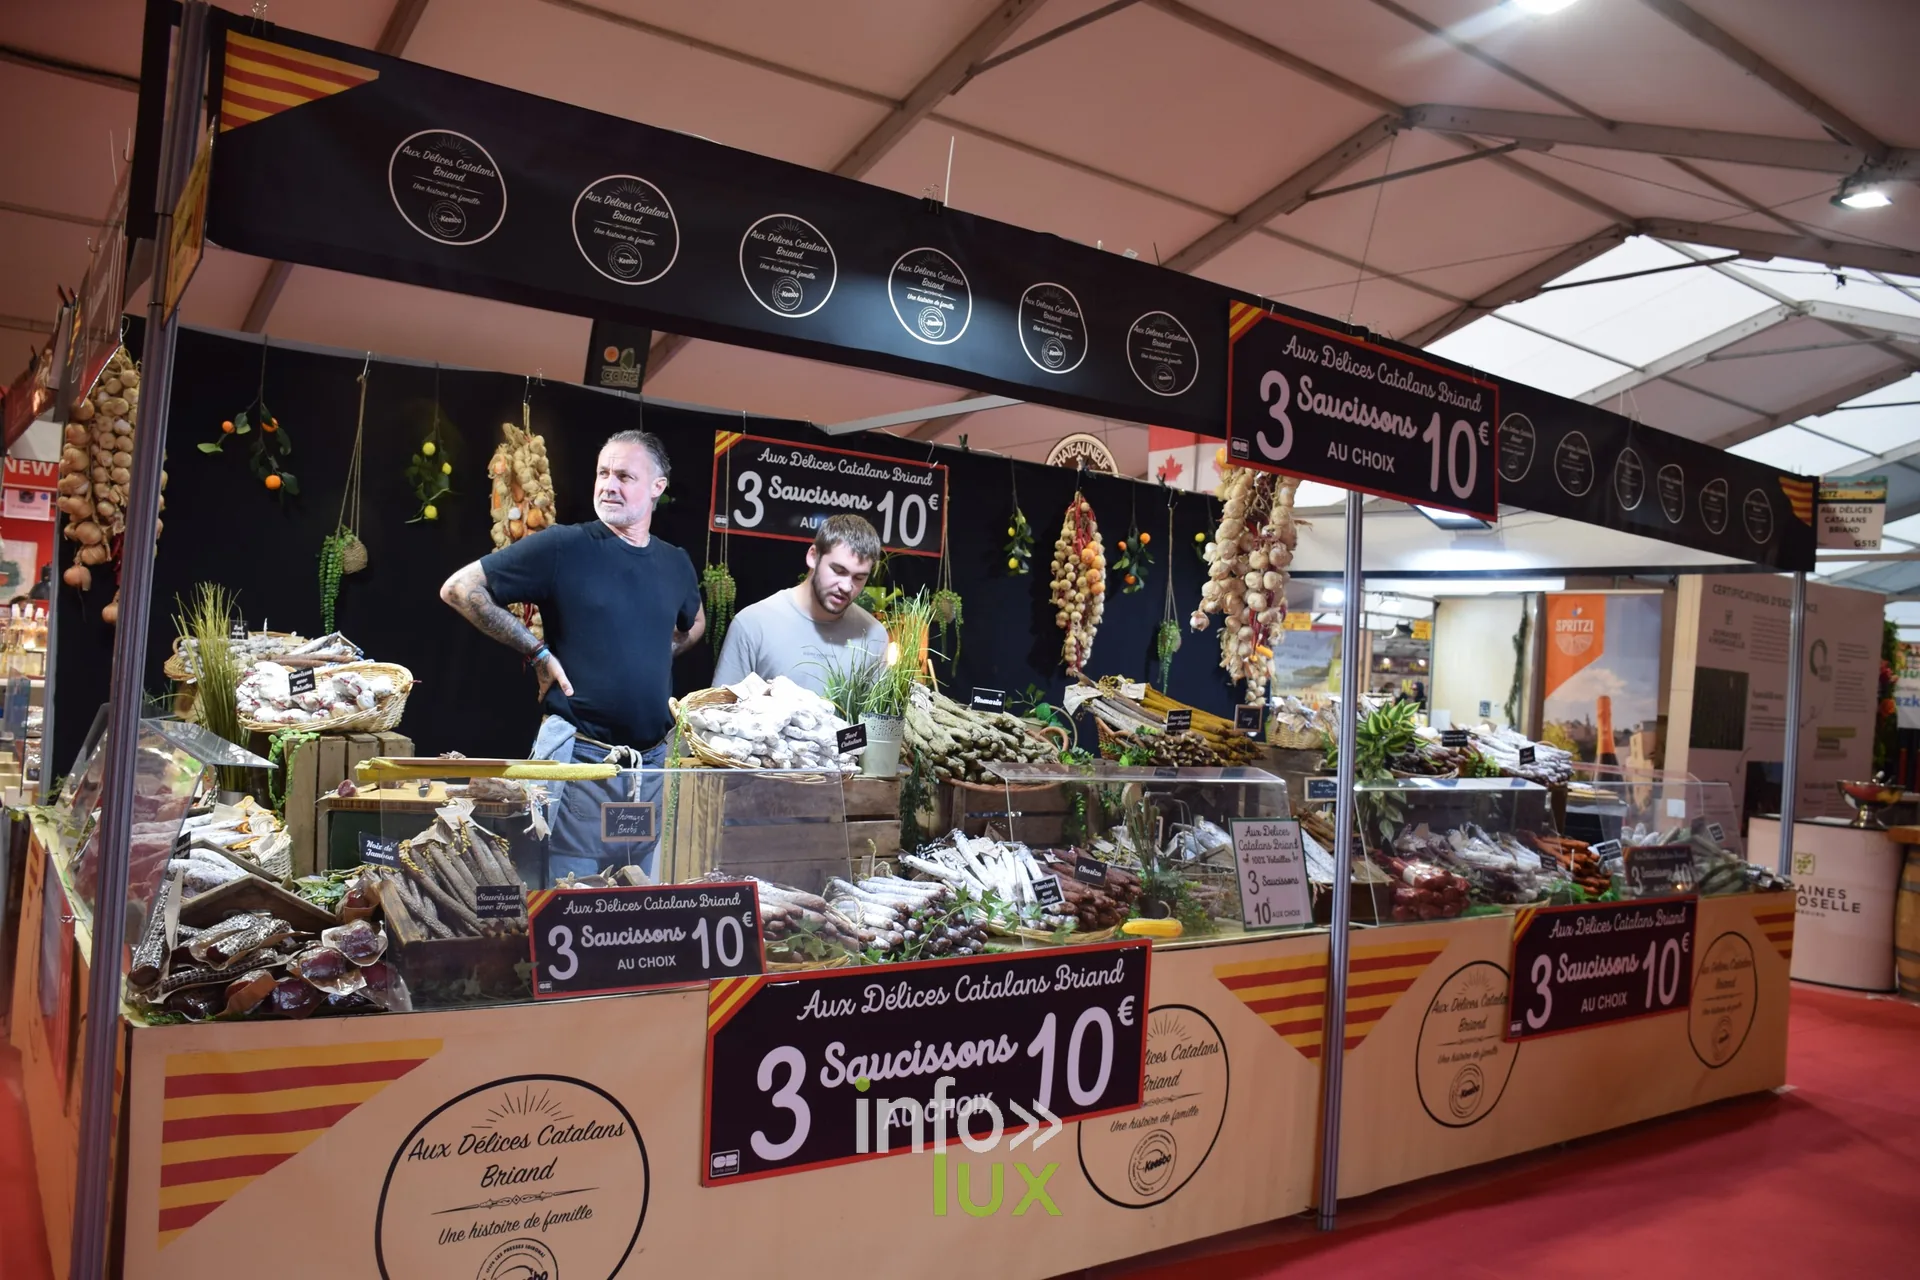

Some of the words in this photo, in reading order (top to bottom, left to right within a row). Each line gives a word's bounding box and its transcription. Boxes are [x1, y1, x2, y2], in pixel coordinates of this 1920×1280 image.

[402, 146, 421, 158] Aux
[423, 150, 453, 167] Délices
[456, 160, 495, 177] Catalans
[433, 167, 466, 182] Briand
[585, 192, 602, 202] Aux
[604, 196, 633, 210] Délices
[634, 203, 669, 219] Catalans
[612, 211, 642, 225] Briand
[751, 230, 766, 241] Aux
[767, 233, 793, 246] Délices
[795, 240, 828, 253] Catalans
[776, 247, 803, 260] Briand
[898, 263, 912, 272] Aux
[913, 265, 936, 277] Délices
[937, 271, 963, 286] Catalans
[922, 278, 944, 290] Briand
[1282, 335, 1319, 363] Aux
[1321, 346, 1375, 380] Délices
[1377, 363, 1436, 398] Catalans
[1438, 382, 1482, 412] Briand
[1256, 370, 1293, 461] 3
[1297, 375, 1417, 439] Saucissons
[5, 456, 54, 476] NEW
[757, 448, 788, 464] Aux
[790, 452, 836, 472] Délices
[838, 459, 891, 480] Catalans
[892, 467, 933, 487] Briand
[1327, 442, 1348, 461] AU
[1352, 447, 1395, 473] CHOIX
[733, 471, 764, 527] 3
[768, 475, 872, 510] Saucissons
[1839, 505, 1872, 513] DÉLICES
[800, 517, 817, 529] AU
[1555, 619, 1594, 633] SPRITZI
[1245, 826, 1261, 837] Aux
[365, 849, 395, 860] Jambon
[366, 840, 382, 850] Noix
[384, 843, 393, 852] de
[1239, 839, 1272, 851] Catalans
[1079, 865, 1102, 877] Chorizo
[1248, 870, 1259, 895] 3
[1262, 876, 1299, 886] Saucissons
[1631, 866, 1644, 895] 3
[477, 893, 520, 901] Saucisson
[563, 900, 593, 915] Aux
[595, 898, 642, 913] Délices
[644, 895, 698, 910] Catalans
[699, 892, 741, 908] Briand
[1549, 919, 1573, 939] Aux
[1574, 916, 1612, 936] Délices
[1613, 911, 1653, 932] Catalans
[1654, 907, 1686, 927] Briand
[548, 925, 579, 980] 3
[581, 925, 686, 948] Saucissons
[617, 959, 634, 970] AU
[638, 955, 676, 968] CHOIX
[796, 990, 856, 1021] Aux
[861, 982, 950, 1014] Délices
[954, 975, 1051, 1001] Catalans
[1054, 959, 1125, 991] Briand
[1526, 954, 1552, 1029] 3
[1557, 952, 1639, 983] Saucissons
[1432, 1001, 1448, 1013] Aux
[1581, 997, 1596, 1014] AU
[1599, 992, 1628, 1011] CHOIX
[1458, 1015, 1488, 1033] Briand
[1170, 1040, 1220, 1061] Catalans
[750, 1045, 811, 1161] 3
[820, 1033, 1019, 1089] Saucissons
[883, 1103, 917, 1131] AU
[924, 1092, 993, 1124] CHOIX
[1110, 1120, 1127, 1133] Une
[1128, 1115, 1159, 1129] histoire
[1160, 1112, 1170, 1122] de
[1170, 1105, 1199, 1126] famille
[407, 1137, 452, 1162] Aux
[457, 1131, 531, 1156] Délices
[536, 1120, 626, 1146] Catalans
[480, 1156, 559, 1189] Briand
[438, 1228, 466, 1245] Une
[468, 1218, 521, 1239] histoire
[523, 1213, 541, 1229] de
[541, 1204, 593, 1234] famille
